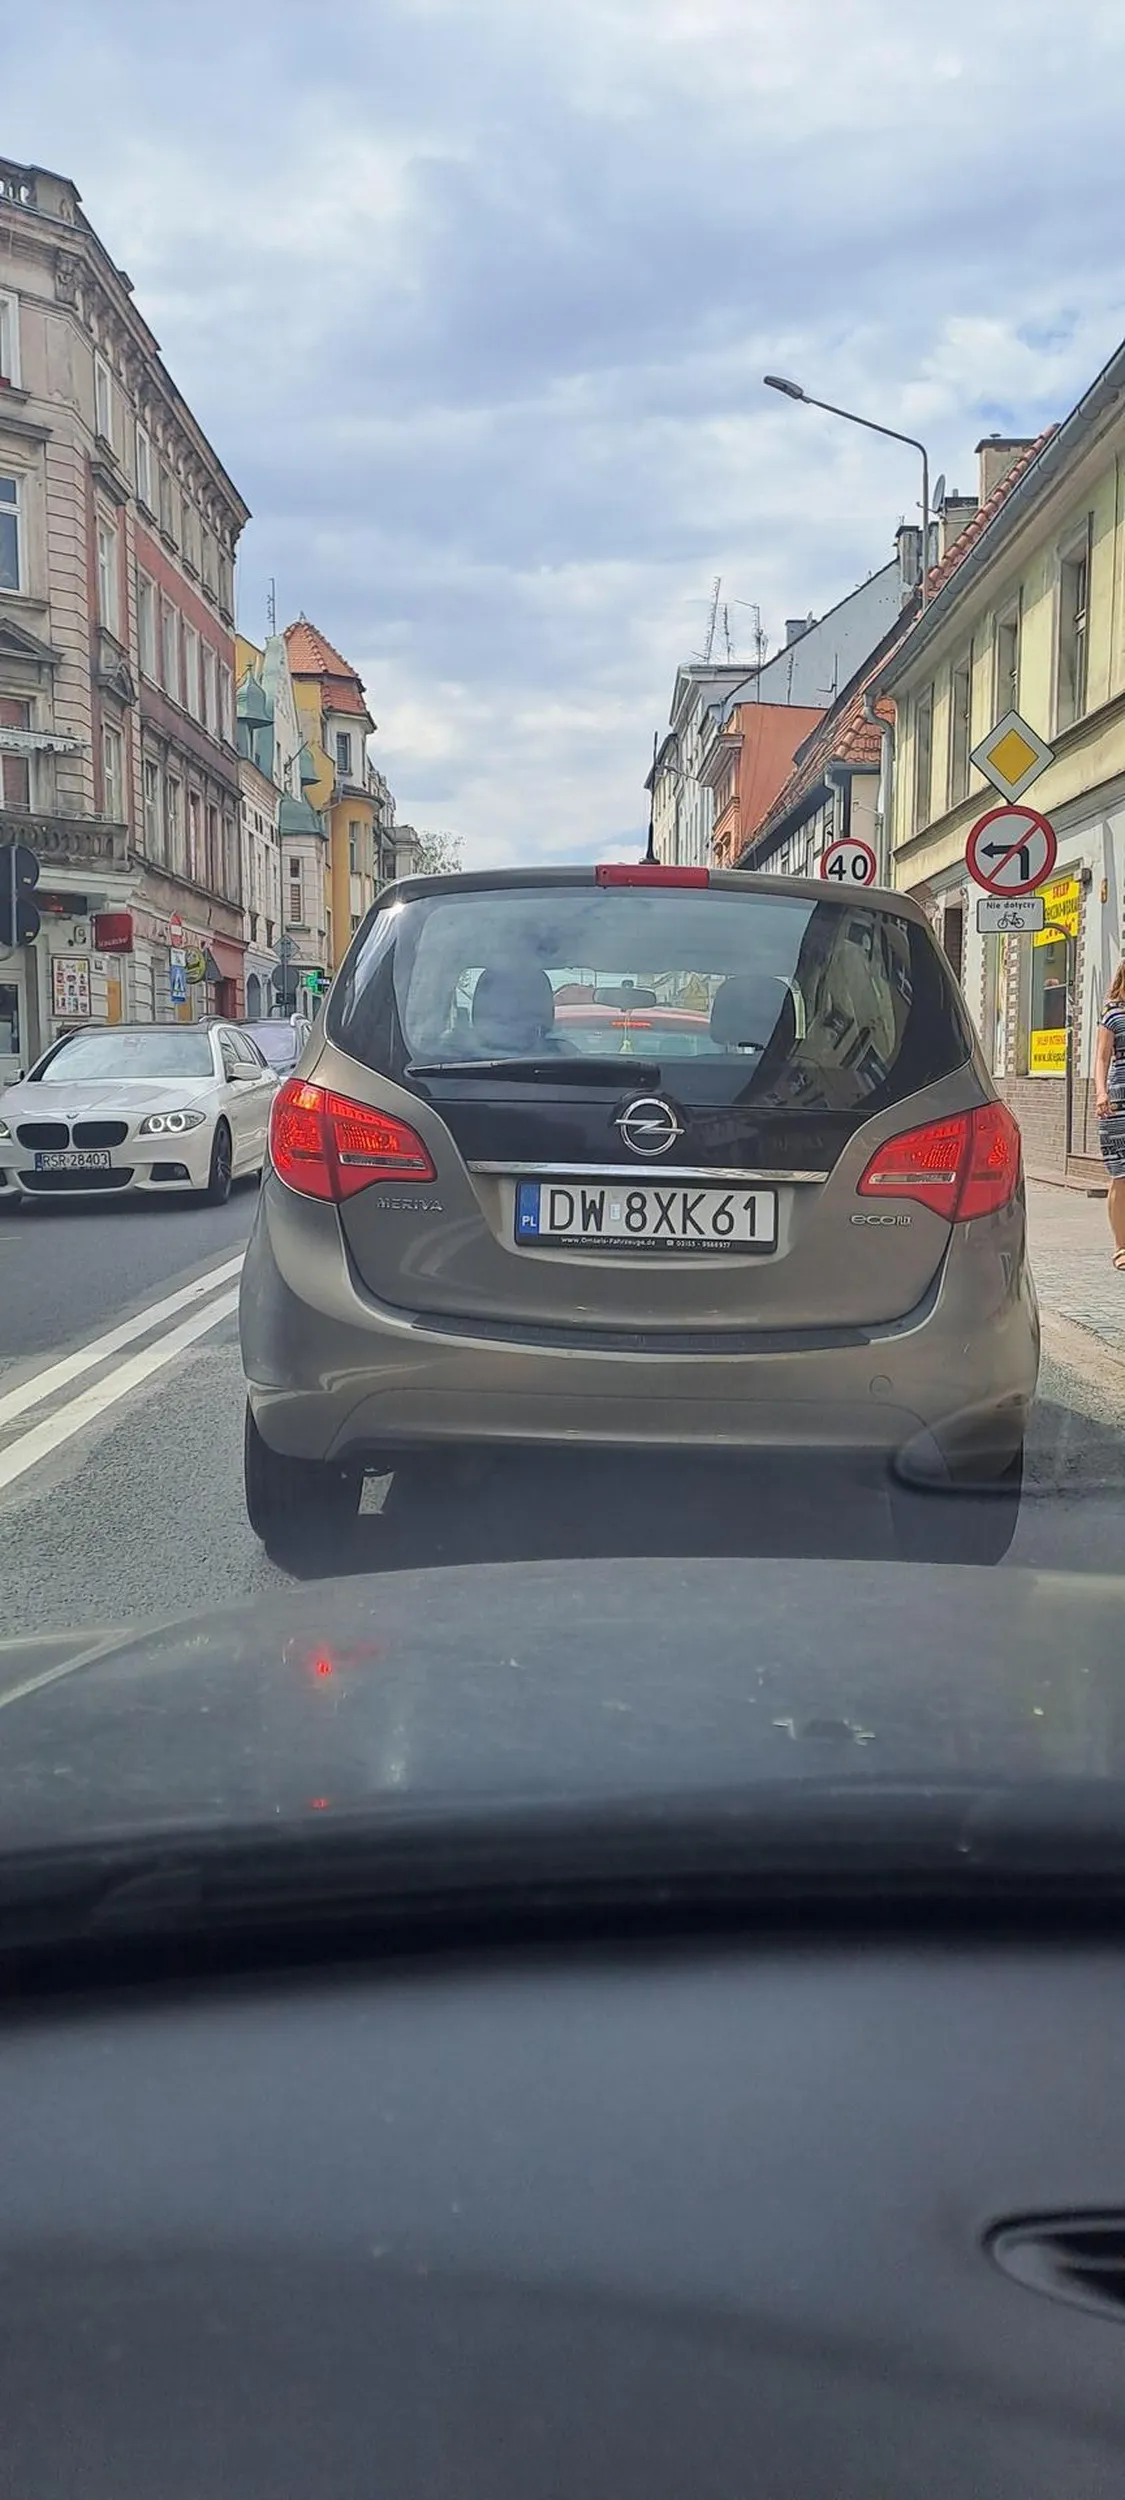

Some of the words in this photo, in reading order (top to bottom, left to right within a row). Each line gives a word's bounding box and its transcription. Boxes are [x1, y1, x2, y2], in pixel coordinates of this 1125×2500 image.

[828, 854, 868, 881] 40
[986, 901, 1001, 910] Nie
[1004, 901, 1036, 910] dotyczy
[43, 1154, 66, 1167] RSR
[70, 1153, 108, 1167] 28403
[377, 1197, 443, 1211] MERIVA
[549, 1189, 605, 1232] DW
[625, 1191, 756, 1237] 8XK61
[522, 1215, 537, 1227] PL
